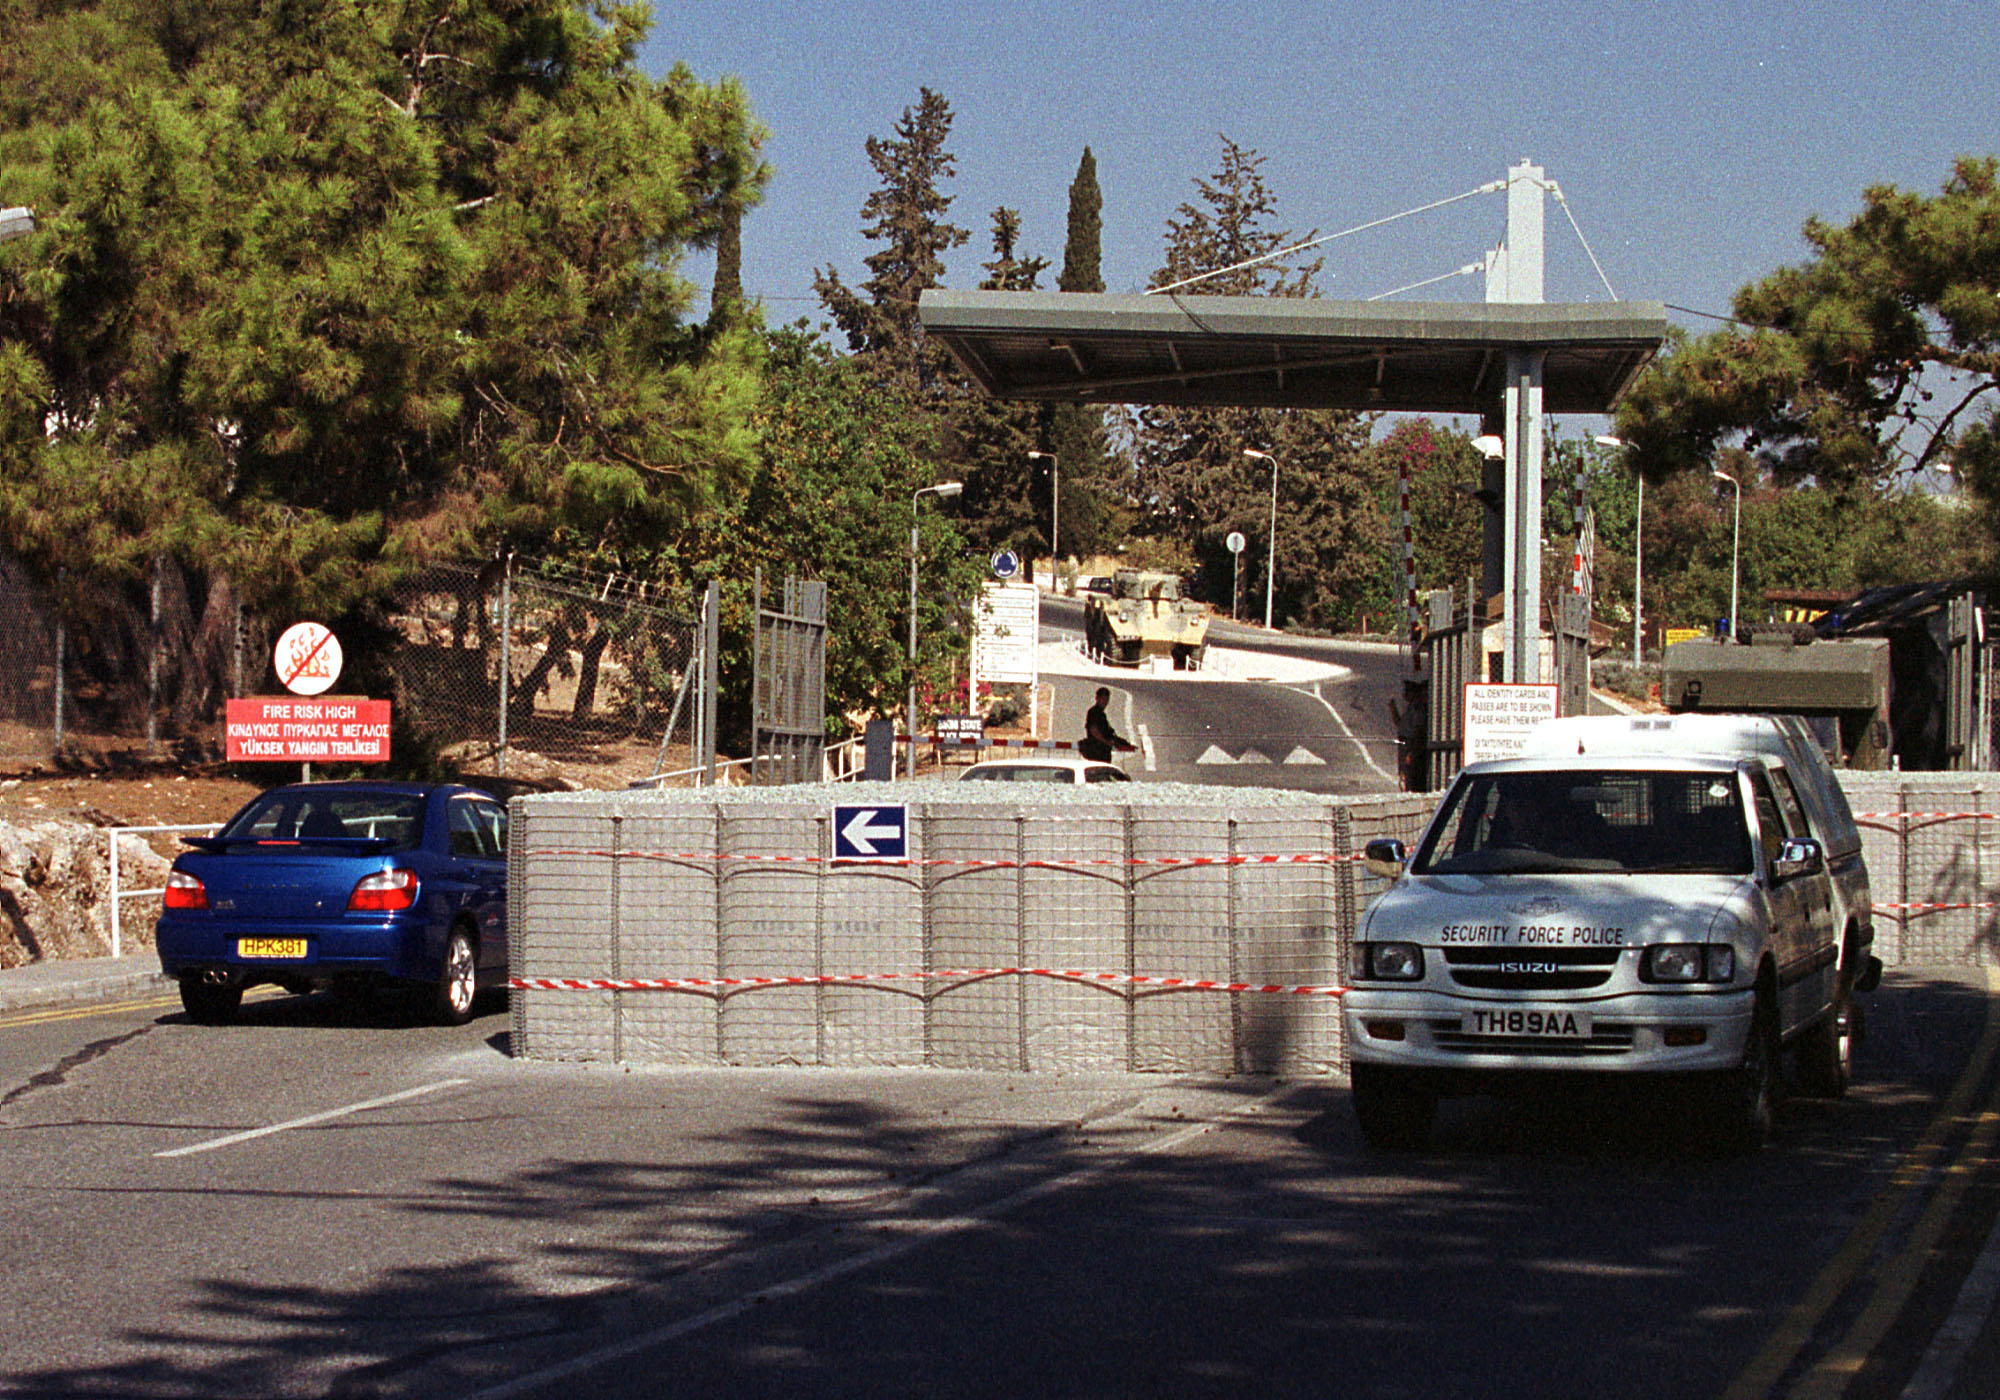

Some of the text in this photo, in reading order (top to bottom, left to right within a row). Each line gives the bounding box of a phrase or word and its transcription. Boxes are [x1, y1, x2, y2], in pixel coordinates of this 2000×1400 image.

[1474, 689, 1550, 699] ALL IDENTITY CARDS AND
[263, 705, 356, 719] FIRE RISK HIGH
[1471, 702, 1552, 712] PASSES ARE TO BE SHOWN
[960, 719, 982, 731] STATE
[1471, 715, 1494, 725] PLEASE
[1496, 715, 1510, 725] HAVE
[1513, 715, 1529, 725] THEM
[228, 723, 389, 737] ΚΙΝΔΥΝΟΣ ΠΥΡΚΑΓΙΑΣ ΜΕΓΑΛΟΣ
[240, 739, 284, 755] YÜKSEK
[288, 741, 328, 755] YANGIN
[1441, 925, 1624, 945] SECURITY FORCE POLICE
[244, 938, 302, 953] HPK381
[1500, 962, 1558, 974] ISUZU
[1473, 1011, 1578, 1035] TH89AA
